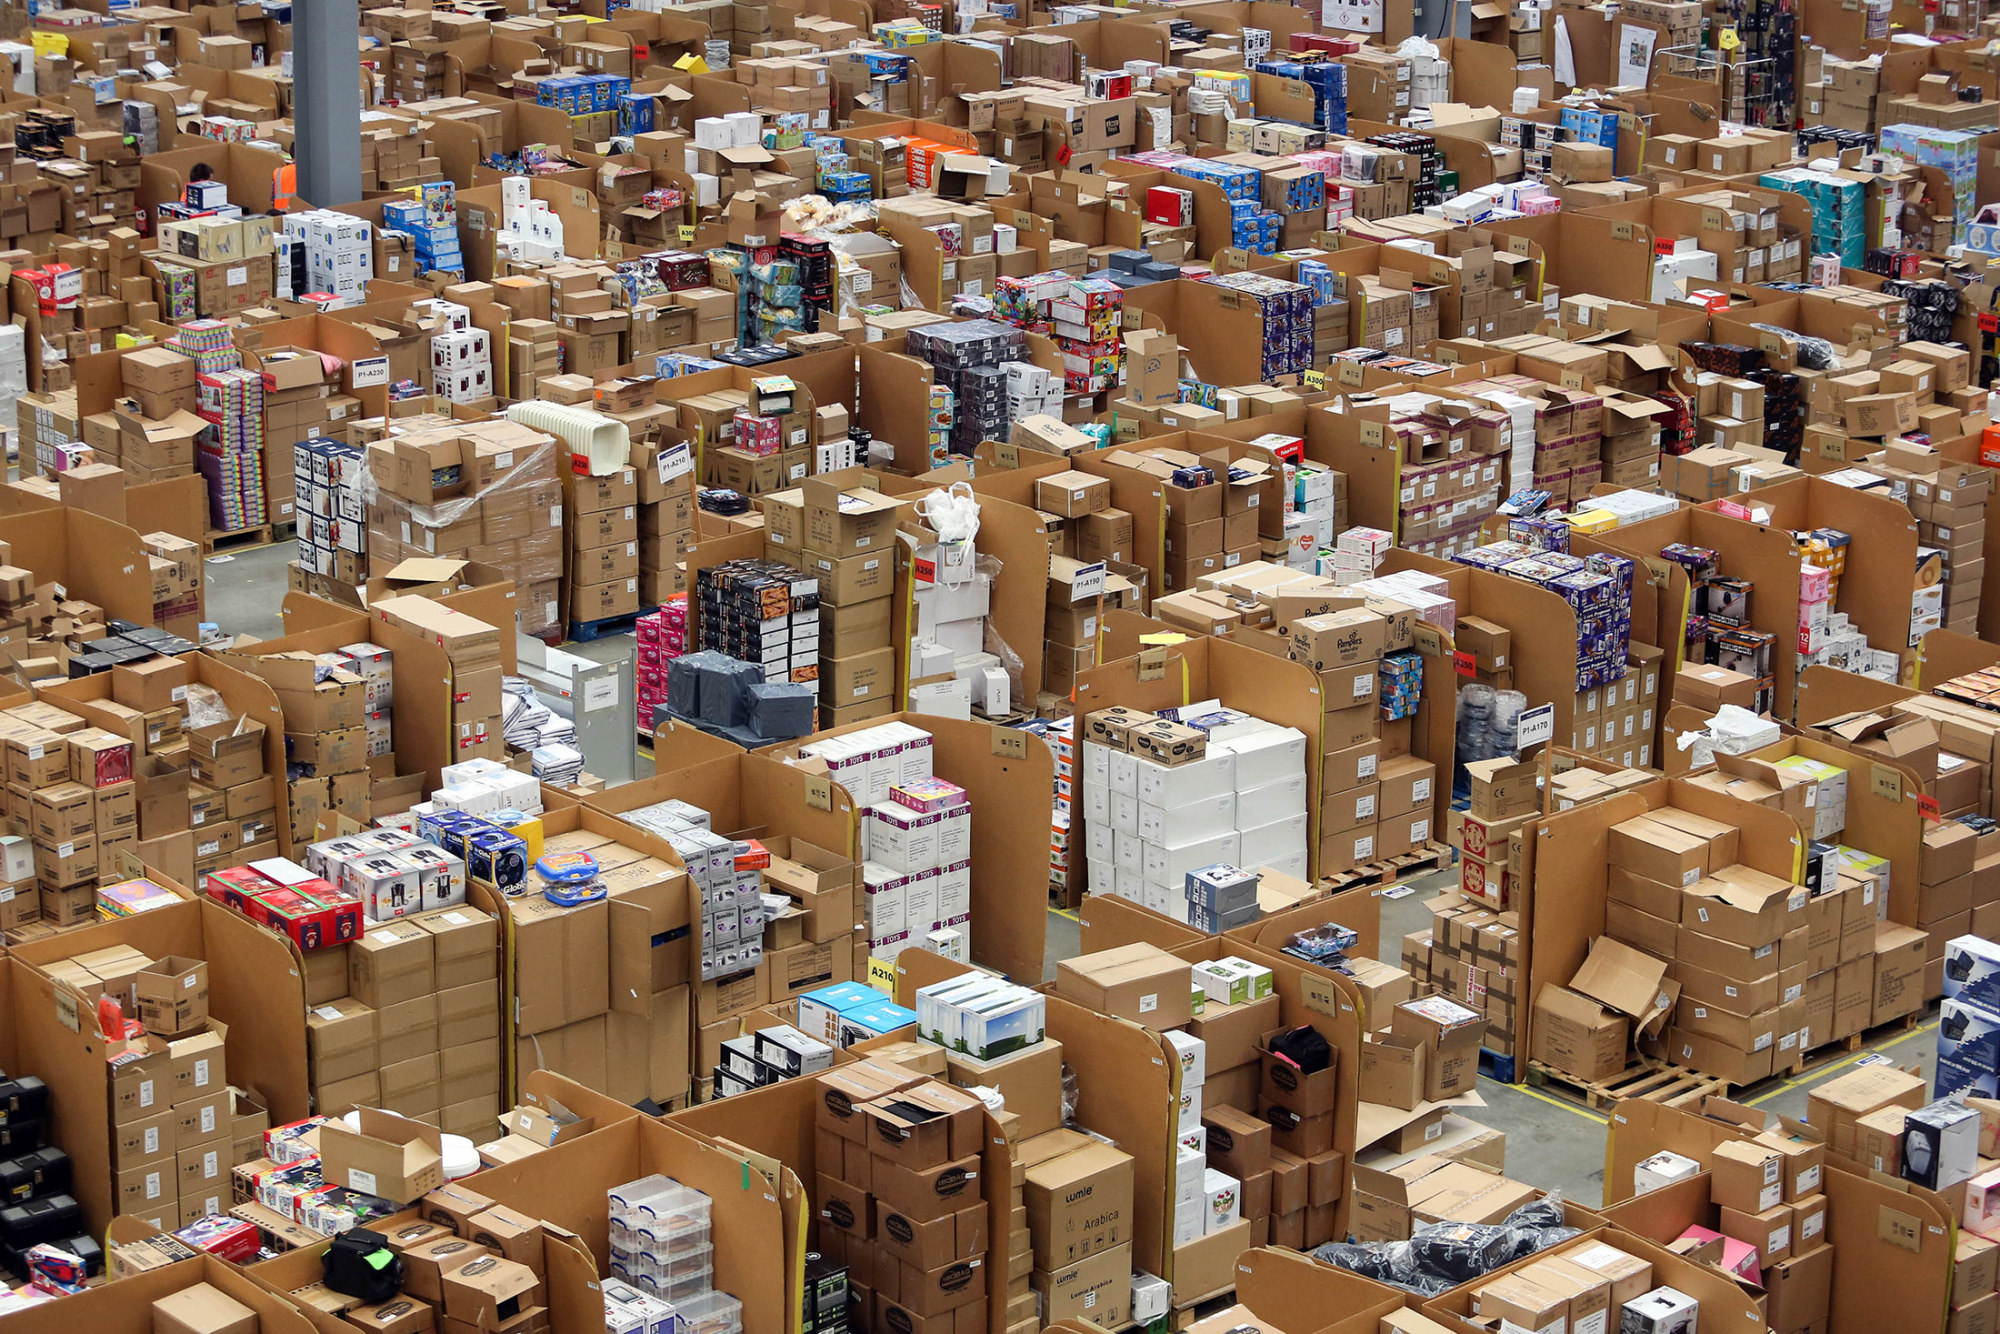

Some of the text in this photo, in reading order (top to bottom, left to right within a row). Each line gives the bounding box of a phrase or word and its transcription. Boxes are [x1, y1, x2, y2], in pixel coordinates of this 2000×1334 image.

[1656, 242, 1672, 250] A350
[358, 369, 384, 379] P1-A230
[1306, 375, 1323, 385] A300
[663, 456, 686, 471] P1-A210
[915, 563, 933, 576] A250
[1076, 576, 1100, 589] P1-A190
[1337, 637, 1362, 649] Pampers
[1801, 634, 1809, 642] 12
[1522, 721, 1548, 735] P1-A170
[914, 738, 929, 747] TOYS
[881, 747, 897, 758] TOYS
[849, 754, 864, 765] TOYS
[952, 806, 967, 816] TOYS
[886, 815, 898, 826] TOYS
[920, 815, 934, 826] TOYS
[710, 846, 729, 856] Breville
[685, 854, 703, 863] Breville
[952, 860, 967, 870] TOYS
[737, 872, 756, 881] Breville
[920, 868, 934, 879] TOYS
[713, 879, 732, 888] Breville
[887, 879, 902, 890] TOYS
[743, 904, 760, 914] Breville
[716, 911, 734, 921] Breville
[952, 914, 966, 923] TOYS
[740, 936, 758, 946] Breville
[886, 933, 901, 943] TOYS
[716, 943, 734, 953] Breville
[871, 966, 893, 982] A210
[1066, 1186, 1094, 1203] Lumie
[1084, 1210, 1119, 1231] Arabica
[1057, 1271, 1078, 1284] Lumie
[1090, 1278, 1112, 1293] Arabica
